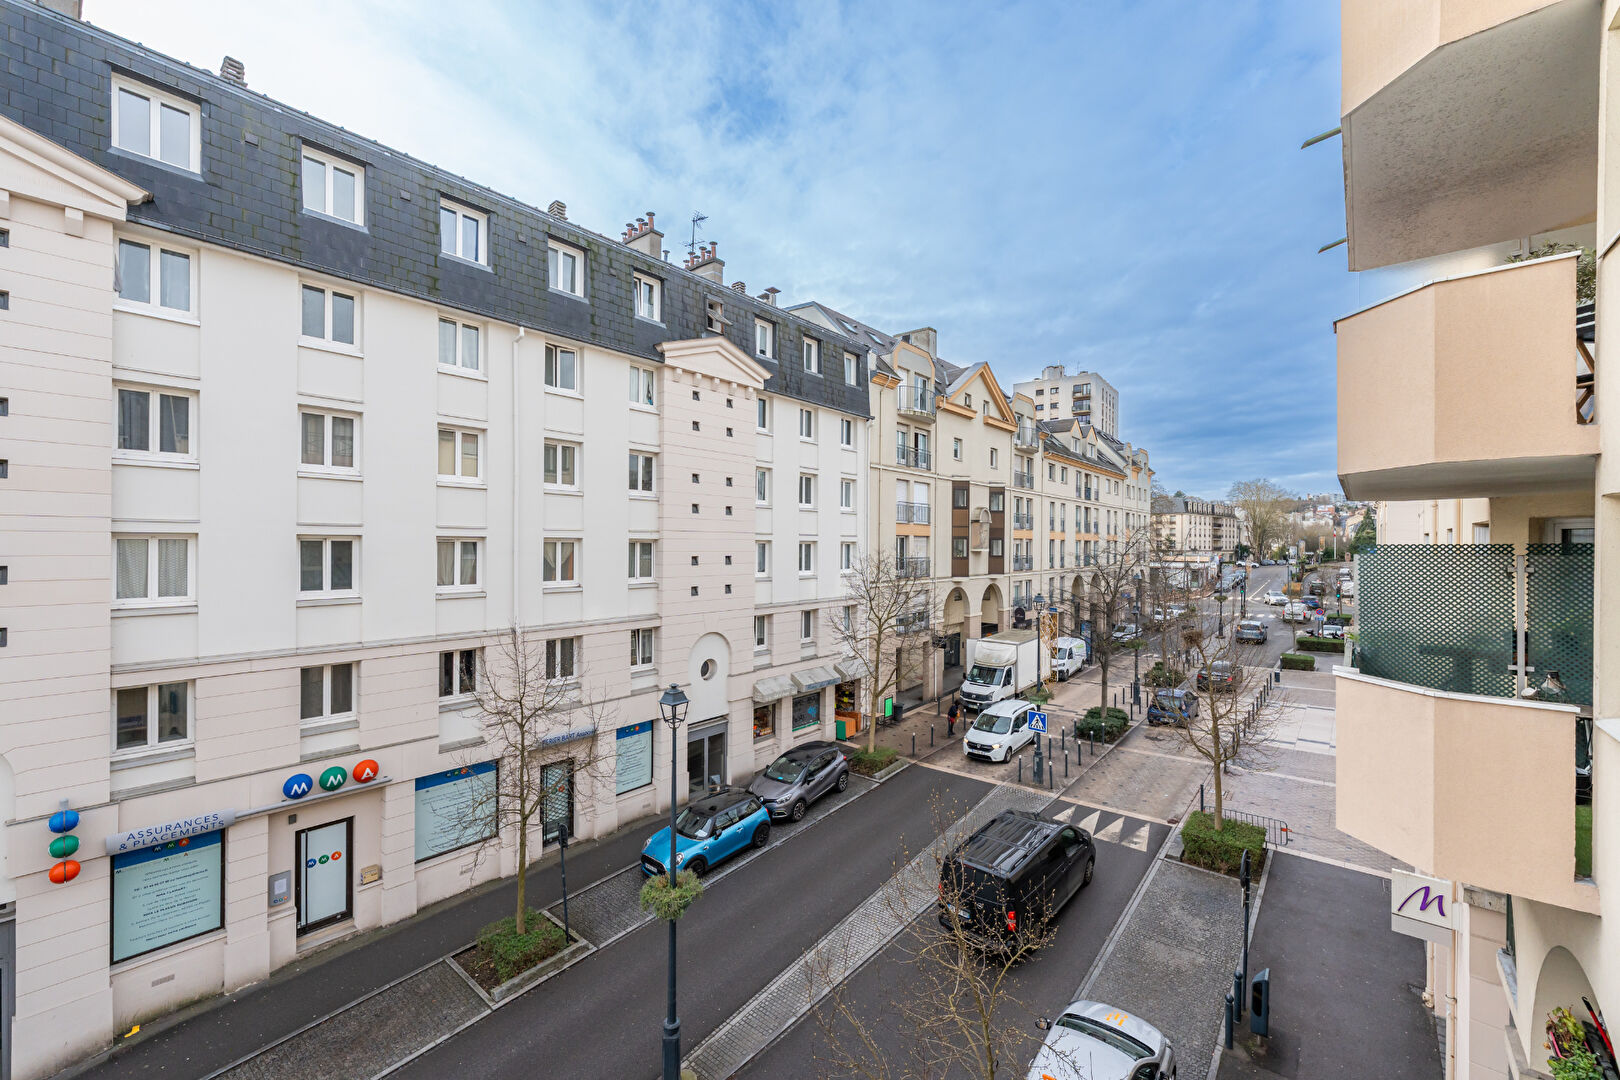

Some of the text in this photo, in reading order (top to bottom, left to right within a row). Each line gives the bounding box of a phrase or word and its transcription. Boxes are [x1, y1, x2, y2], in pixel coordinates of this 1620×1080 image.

[119, 820, 225, 851] & PLACEMENTS
[126, 813, 219, 842] ASSURANCES
